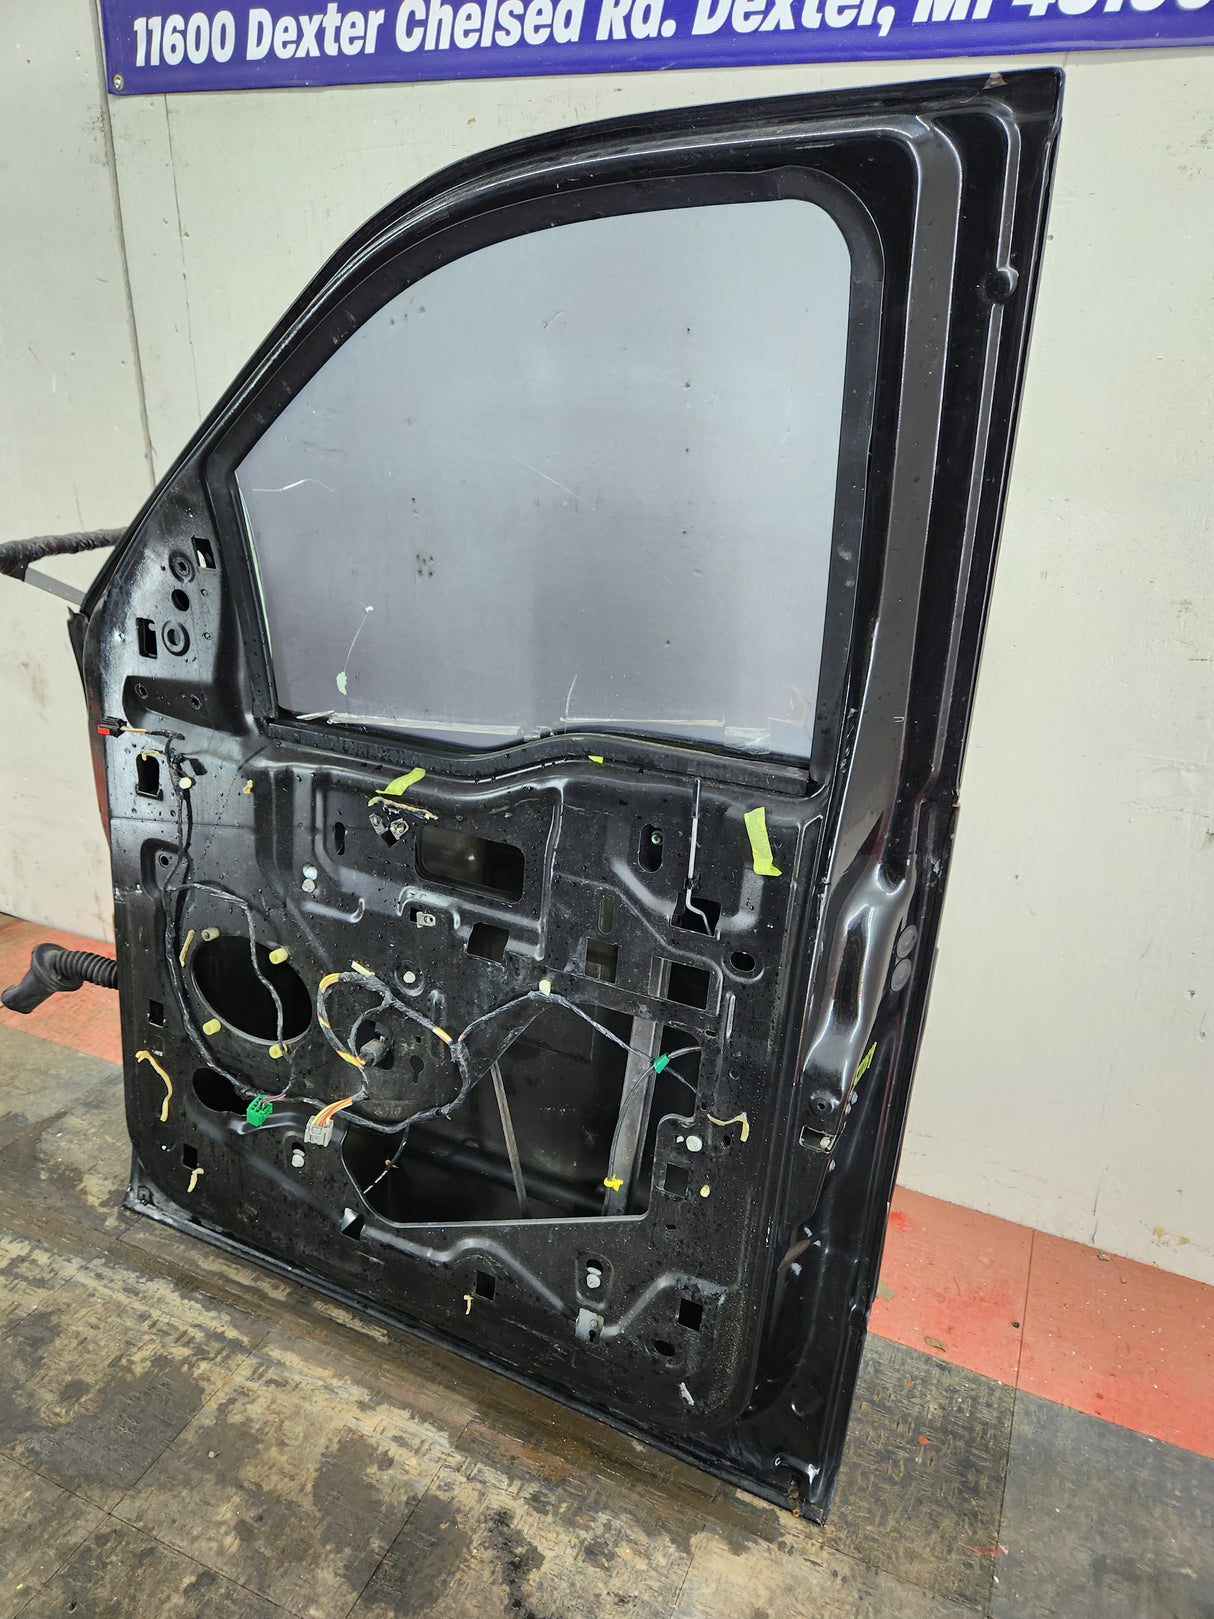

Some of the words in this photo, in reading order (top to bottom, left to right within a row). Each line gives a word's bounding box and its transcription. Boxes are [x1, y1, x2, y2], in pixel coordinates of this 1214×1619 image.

[133, 10, 236, 67] 11600
[246, 2, 385, 61] Dexter
[395, 0, 585, 53] Chelsea
[595, 0, 677, 41] Rd.
